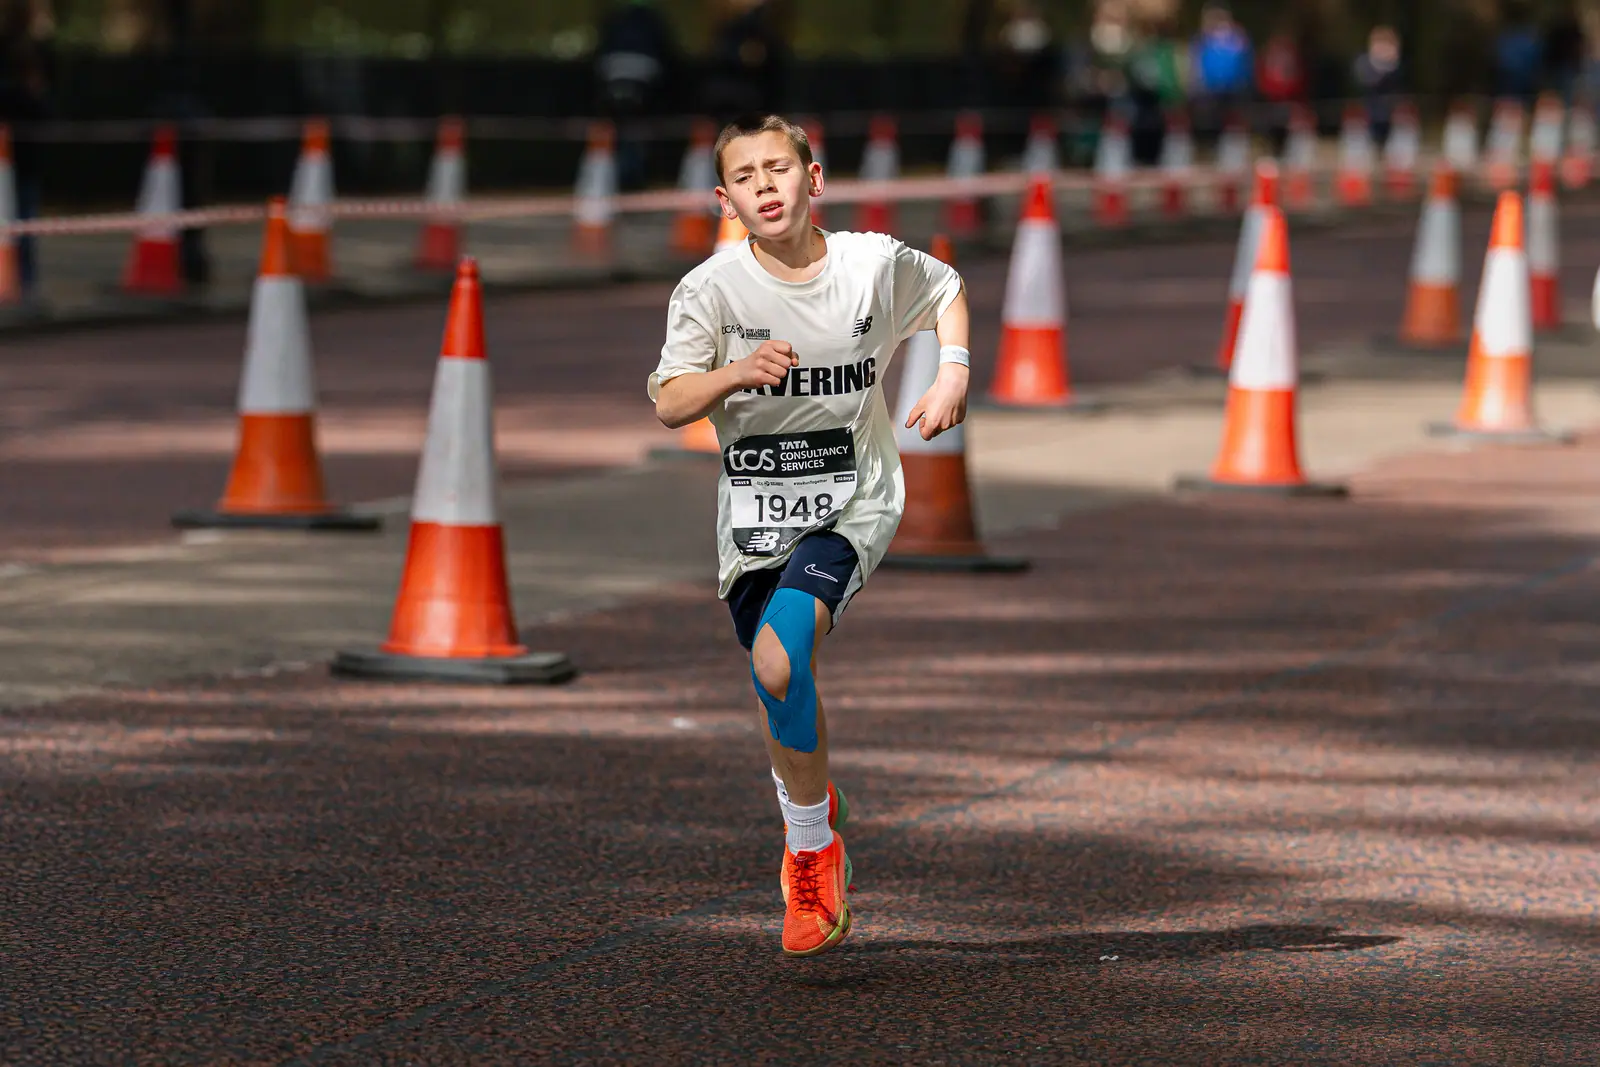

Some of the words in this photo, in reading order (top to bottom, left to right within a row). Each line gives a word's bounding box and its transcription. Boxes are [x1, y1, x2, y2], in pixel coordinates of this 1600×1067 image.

[729, 357, 876, 397] VERING
[779, 440, 809, 450] TATA
[780, 445, 849, 461] CONSULTANCY
[728, 445, 776, 472] tcs
[781, 459, 825, 472] SERVICES
[754, 492, 834, 523] 1948
